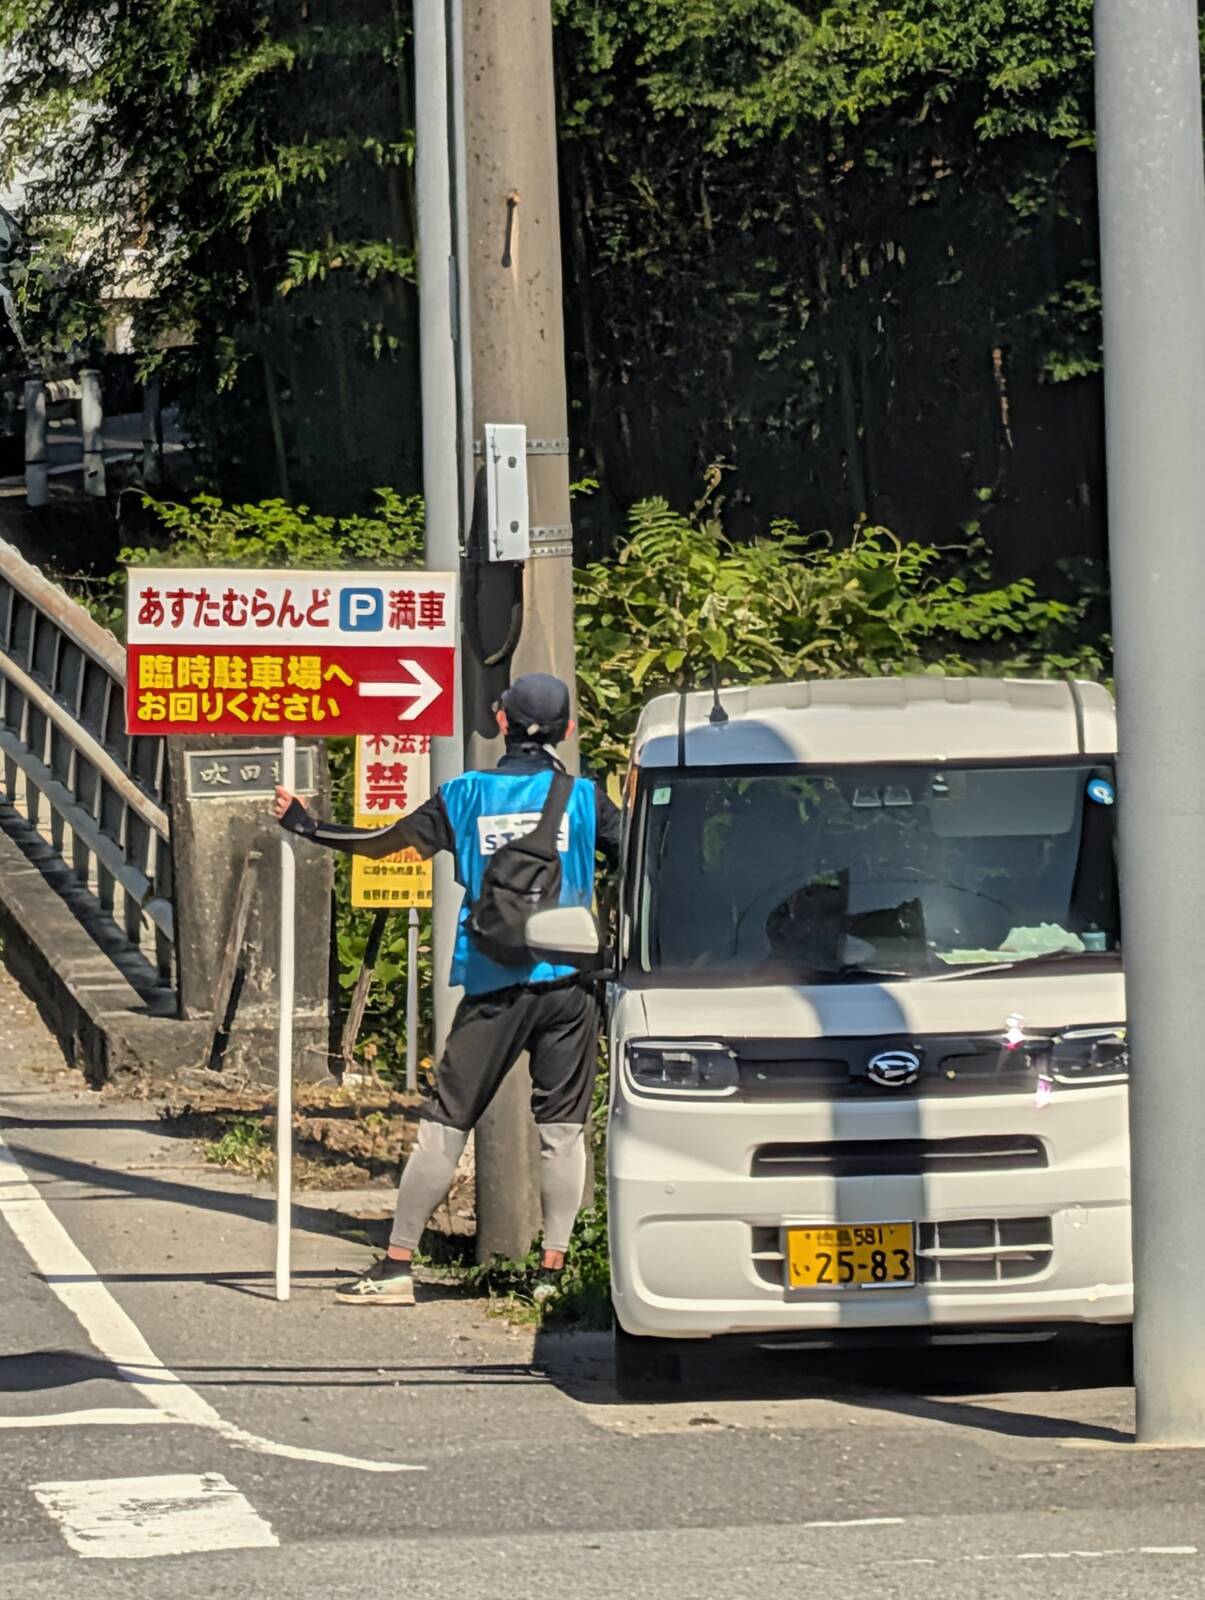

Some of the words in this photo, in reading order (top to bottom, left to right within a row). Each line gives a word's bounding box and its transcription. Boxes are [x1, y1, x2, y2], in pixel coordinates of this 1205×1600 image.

[138, 587, 331, 628] あすたむらんど
[350, 594, 376, 627] P
[388, 590, 446, 630] 満車
[138, 655, 354, 690] 臨時駐車場へ
[136, 692, 341, 722] お回りください
[815, 1249, 911, 1284] 25-83
